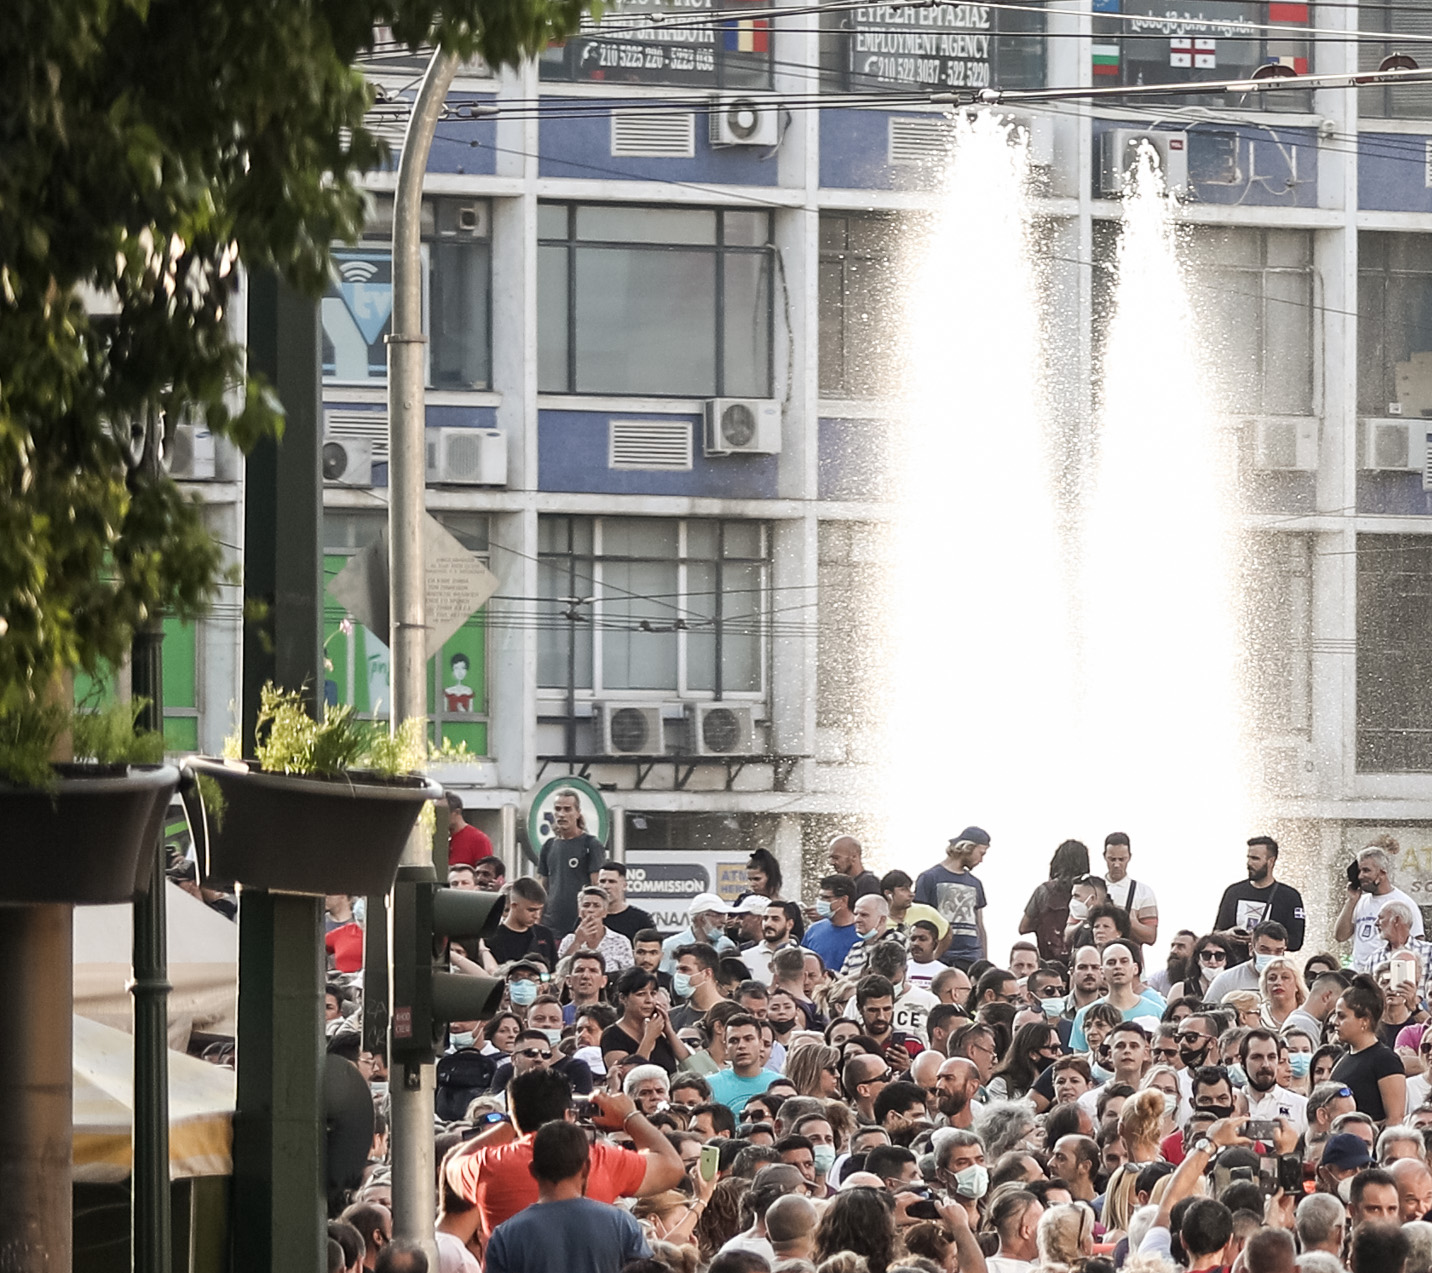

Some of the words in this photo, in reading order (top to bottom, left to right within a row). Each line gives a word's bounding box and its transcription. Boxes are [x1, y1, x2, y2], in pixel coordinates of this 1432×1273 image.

[919, 6, 991, 29] ΕΡΓΑΣΙΑΣ
[856, 25, 940, 56] EMPLOYMENT
[940, 32, 991, 59] AGENCY
[600, 44, 618, 67] 210
[946, 60, 965, 86] 522
[966, 61, 990, 88] 5220
[626, 869, 646, 880] NO
[626, 881, 705, 893] COMMISSION
